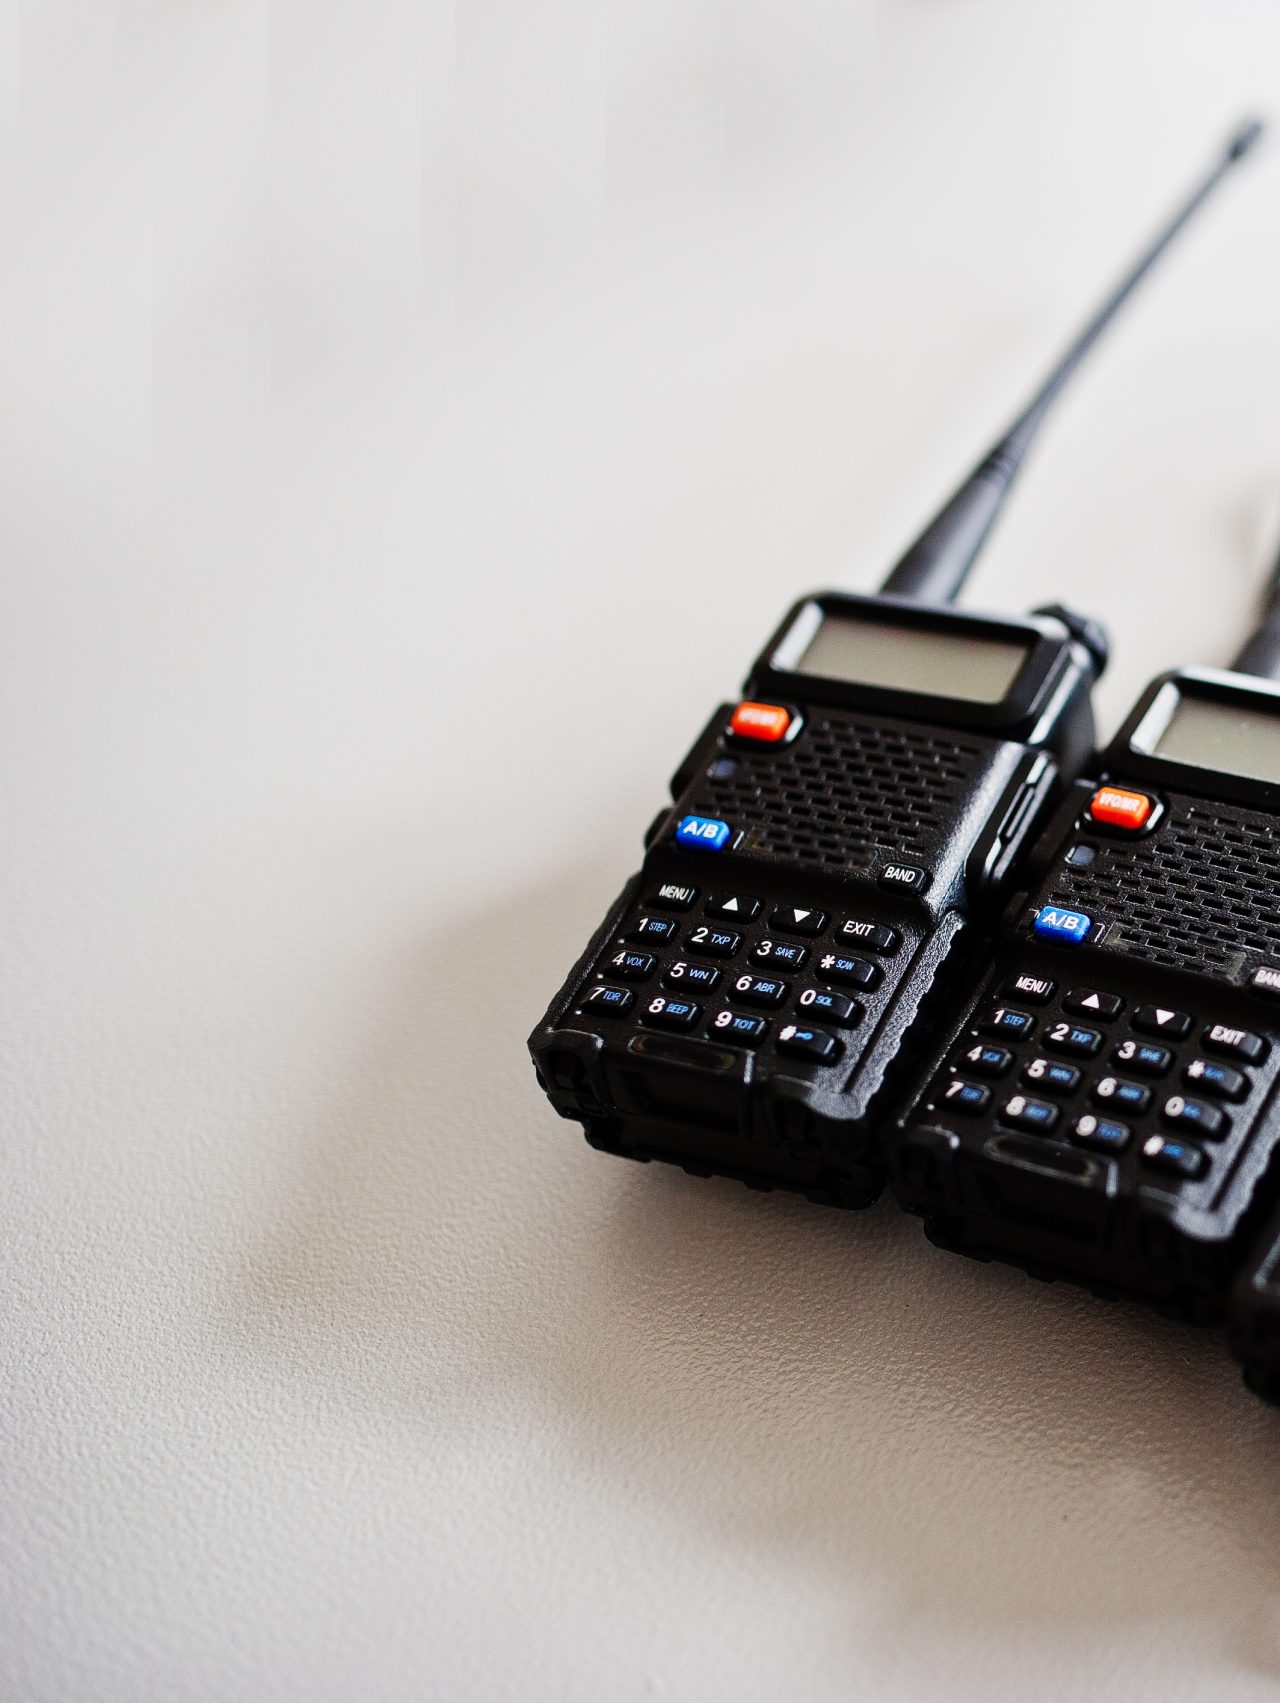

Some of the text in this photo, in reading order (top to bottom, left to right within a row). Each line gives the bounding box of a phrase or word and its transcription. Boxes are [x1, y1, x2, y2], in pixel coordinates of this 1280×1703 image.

[683, 821, 718, 838] A/B
[884, 866, 916, 883] BAND
[659, 884, 689, 901] MENU
[638, 917, 668, 933] 1 STEP
[843, 920, 875, 937] EXIT
[1042, 912, 1078, 929] A/B
[691, 927, 731, 945] 2 TXP
[756, 940, 797, 959] 3 SAVE
[612, 951, 646, 967] 4 VOX
[670, 962, 710, 980] 5 WN
[735, 975, 776, 994] 6 ABR
[1015, 975, 1047, 993] MENU
[589, 986, 622, 1001] 7 TDR
[799, 989, 817, 1006] 0
[648, 997, 666, 1013] 8
[714, 1011, 757, 1031] 9 TOT
[993, 1009, 1026, 1027] 1 STEP
[1050, 1023, 1069, 1041] 2
[1209, 1024, 1247, 1046] EXIT
[966, 1045, 983, 1061] 4
[1117, 1040, 1136, 1059] 3
[1027, 1058, 1048, 1078] 5
[944, 1080, 965, 1099] 7
[1096, 1077, 1117, 1097] 6
[1005, 1095, 1026, 1116] 8
